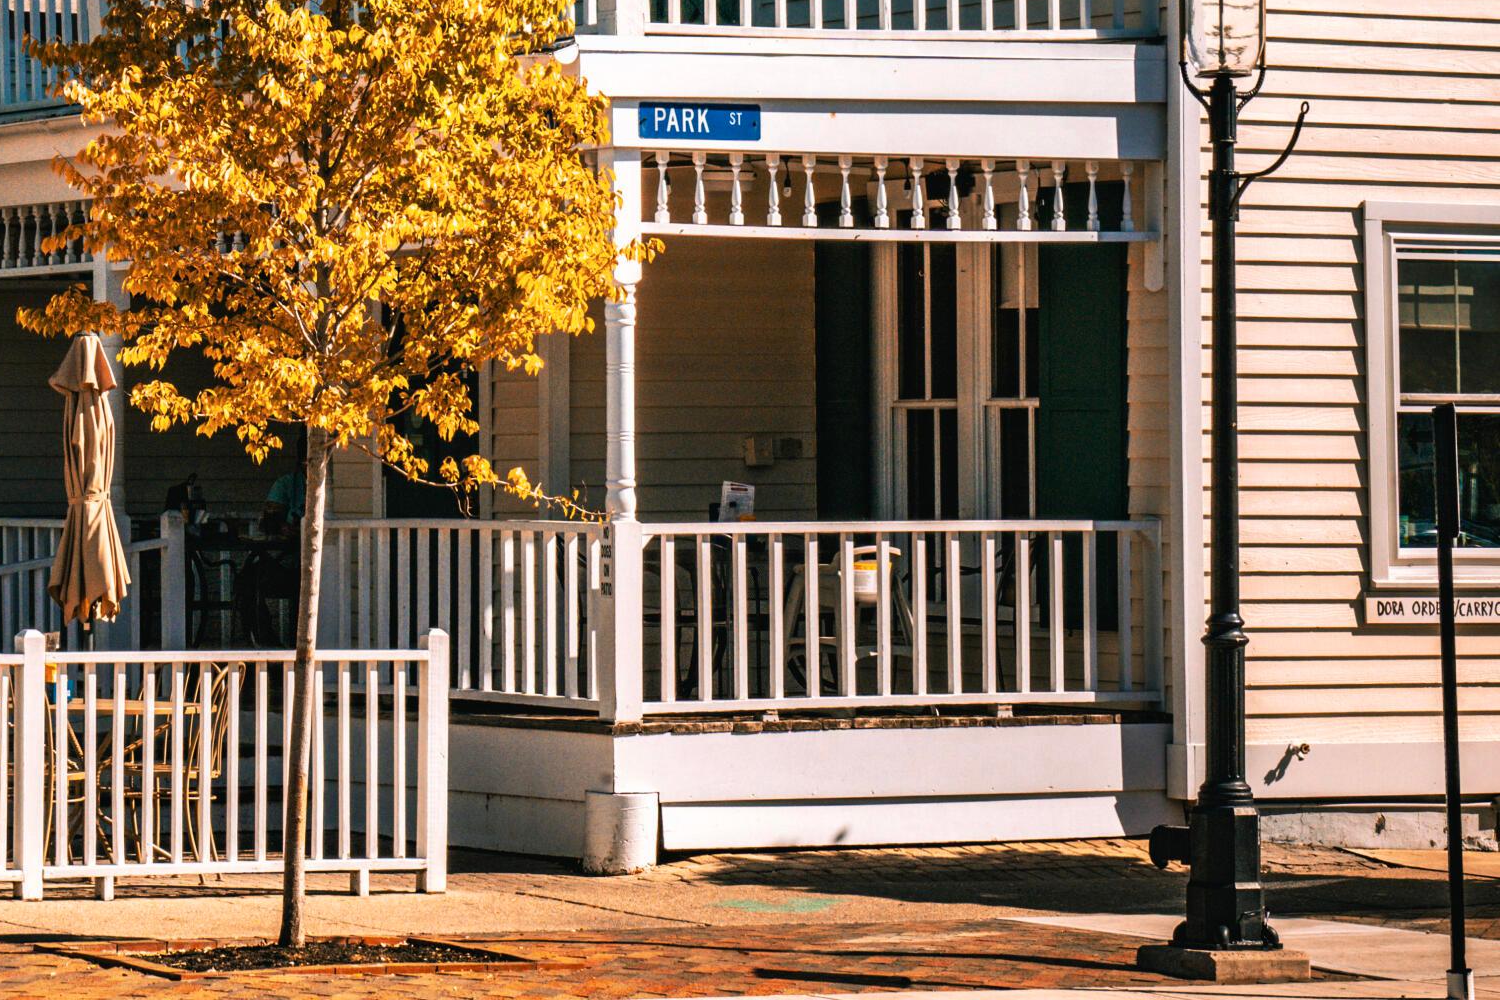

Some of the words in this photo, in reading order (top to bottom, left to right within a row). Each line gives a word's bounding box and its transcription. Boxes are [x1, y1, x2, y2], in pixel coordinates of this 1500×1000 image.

[654, 107, 710, 133] PARK
[729, 112, 742, 126] ST
[1377, 600, 1405, 616] DORA
